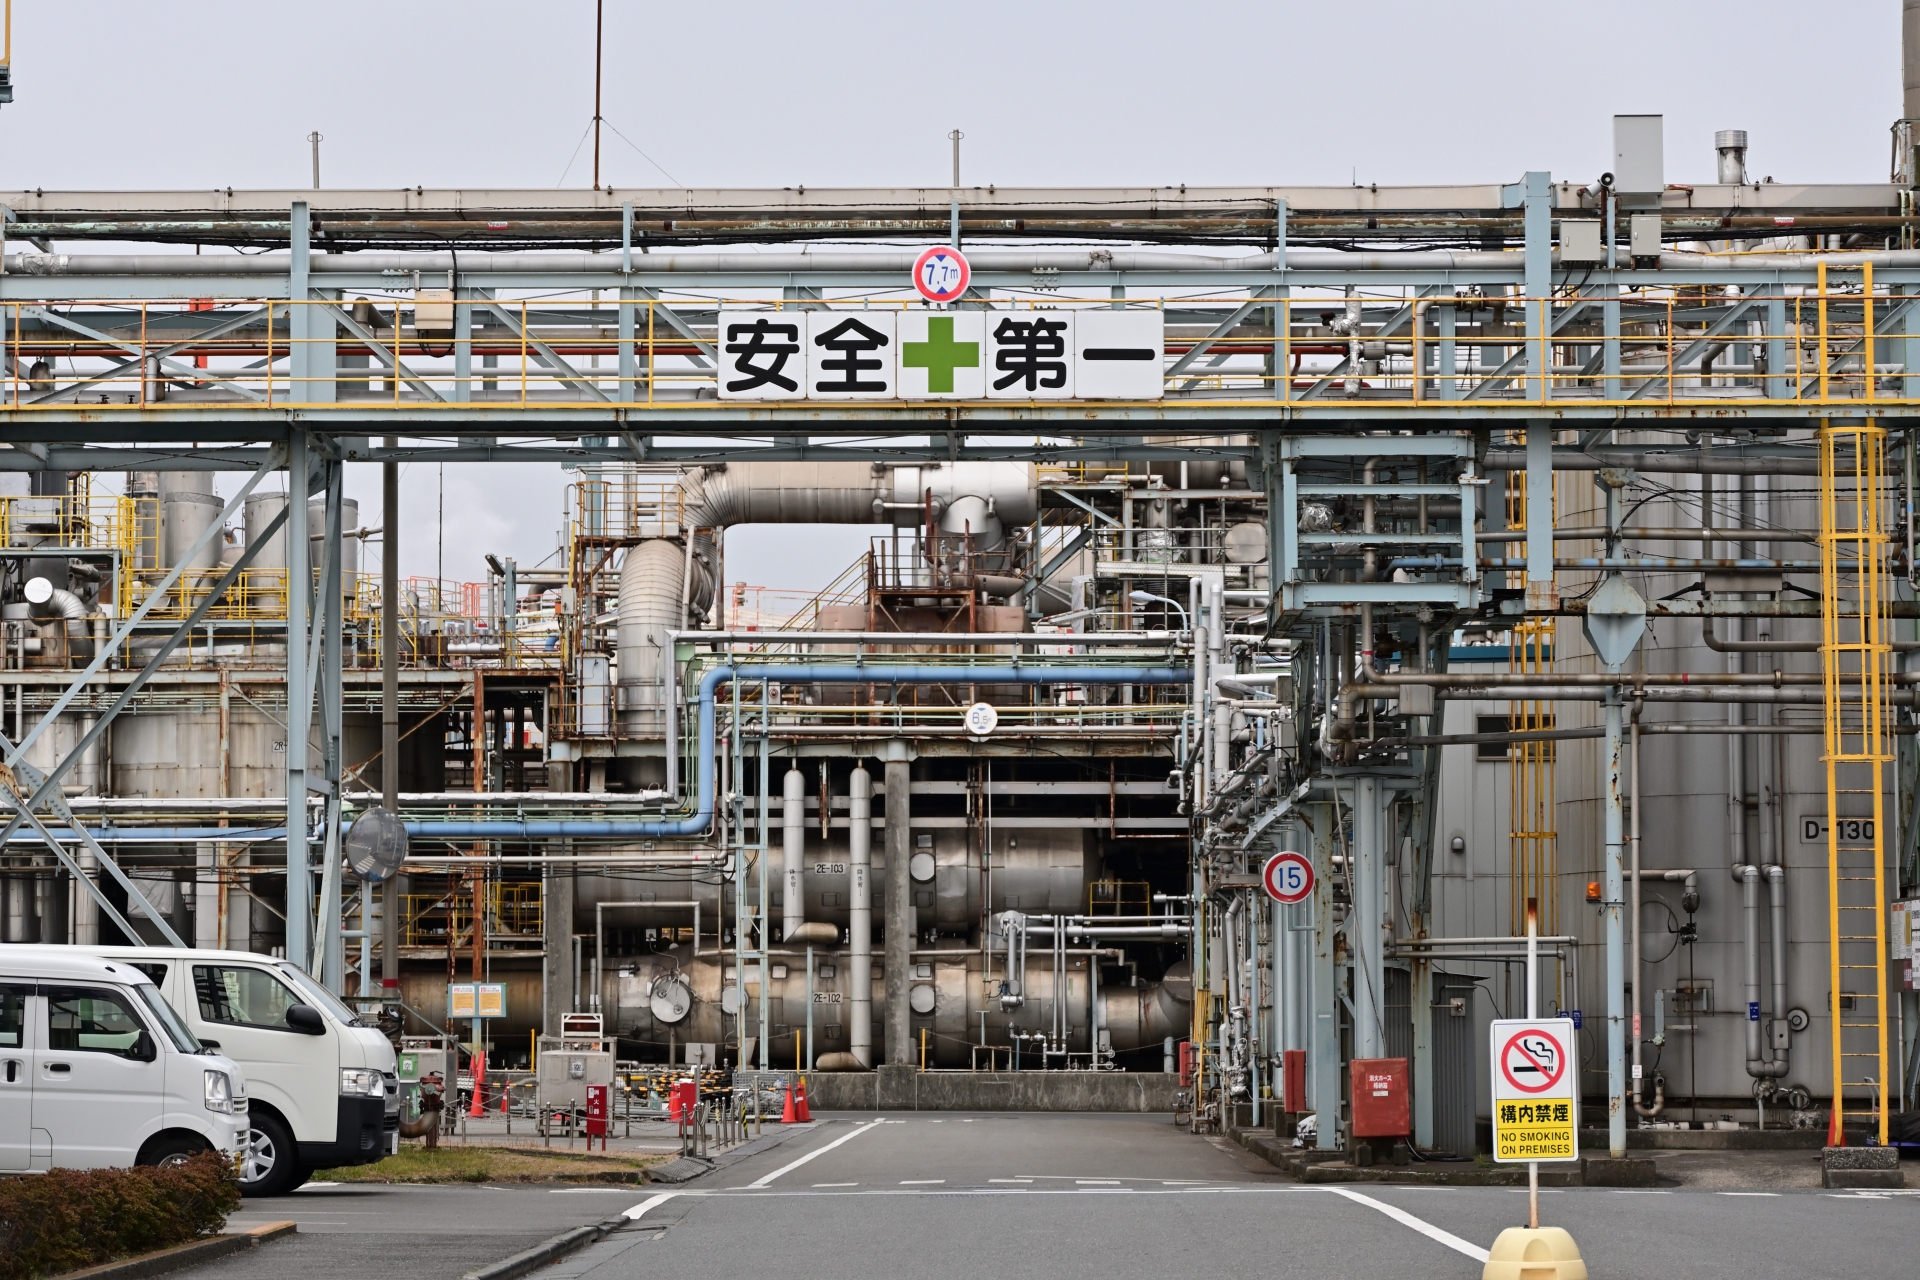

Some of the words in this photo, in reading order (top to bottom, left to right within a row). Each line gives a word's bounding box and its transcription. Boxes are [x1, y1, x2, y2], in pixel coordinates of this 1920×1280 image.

[925, 263, 959, 285] 7.7m
[725, 317, 889, 393] 安全
[993, 317, 1156, 392] 第一
[816, 864, 844, 874] 2E-103
[1278, 866, 1302, 889] 15
[813, 993, 841, 1003] 2E-102
[1500, 1104, 1569, 1124] 構内禁煙
[1501, 1132, 1517, 1142] NO
[1520, 1131, 1570, 1142] SMOKING
[1501, 1145, 1516, 1155] ON
[1520, 1144, 1570, 1154] PREMISES
